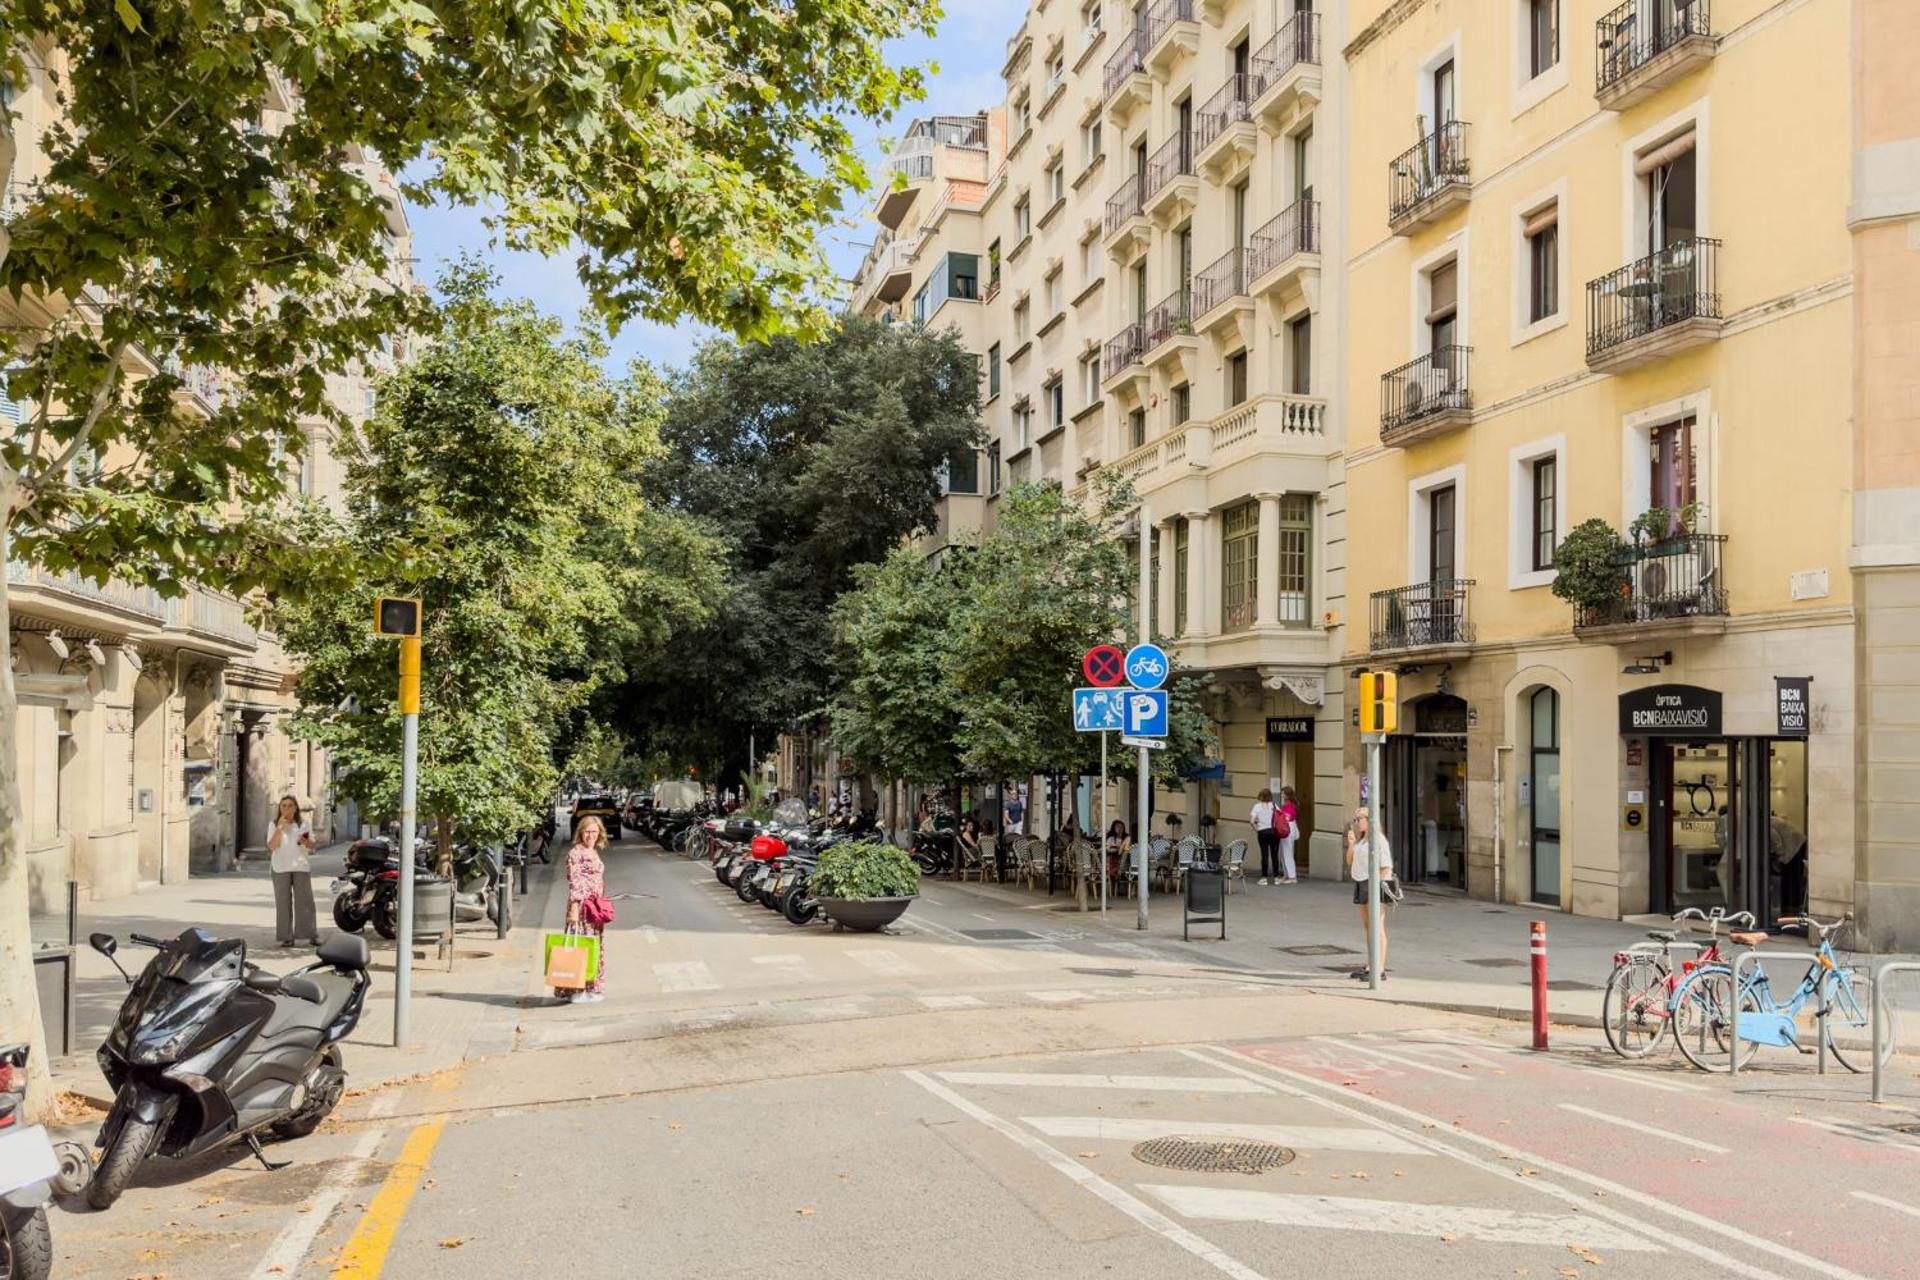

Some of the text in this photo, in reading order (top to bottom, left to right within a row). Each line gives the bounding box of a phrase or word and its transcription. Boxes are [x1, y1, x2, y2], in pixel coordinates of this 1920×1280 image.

[1781, 688, 1800, 701] BCN
[1131, 694, 1159, 732] P
[1781, 701, 1806, 715] BAIXA
